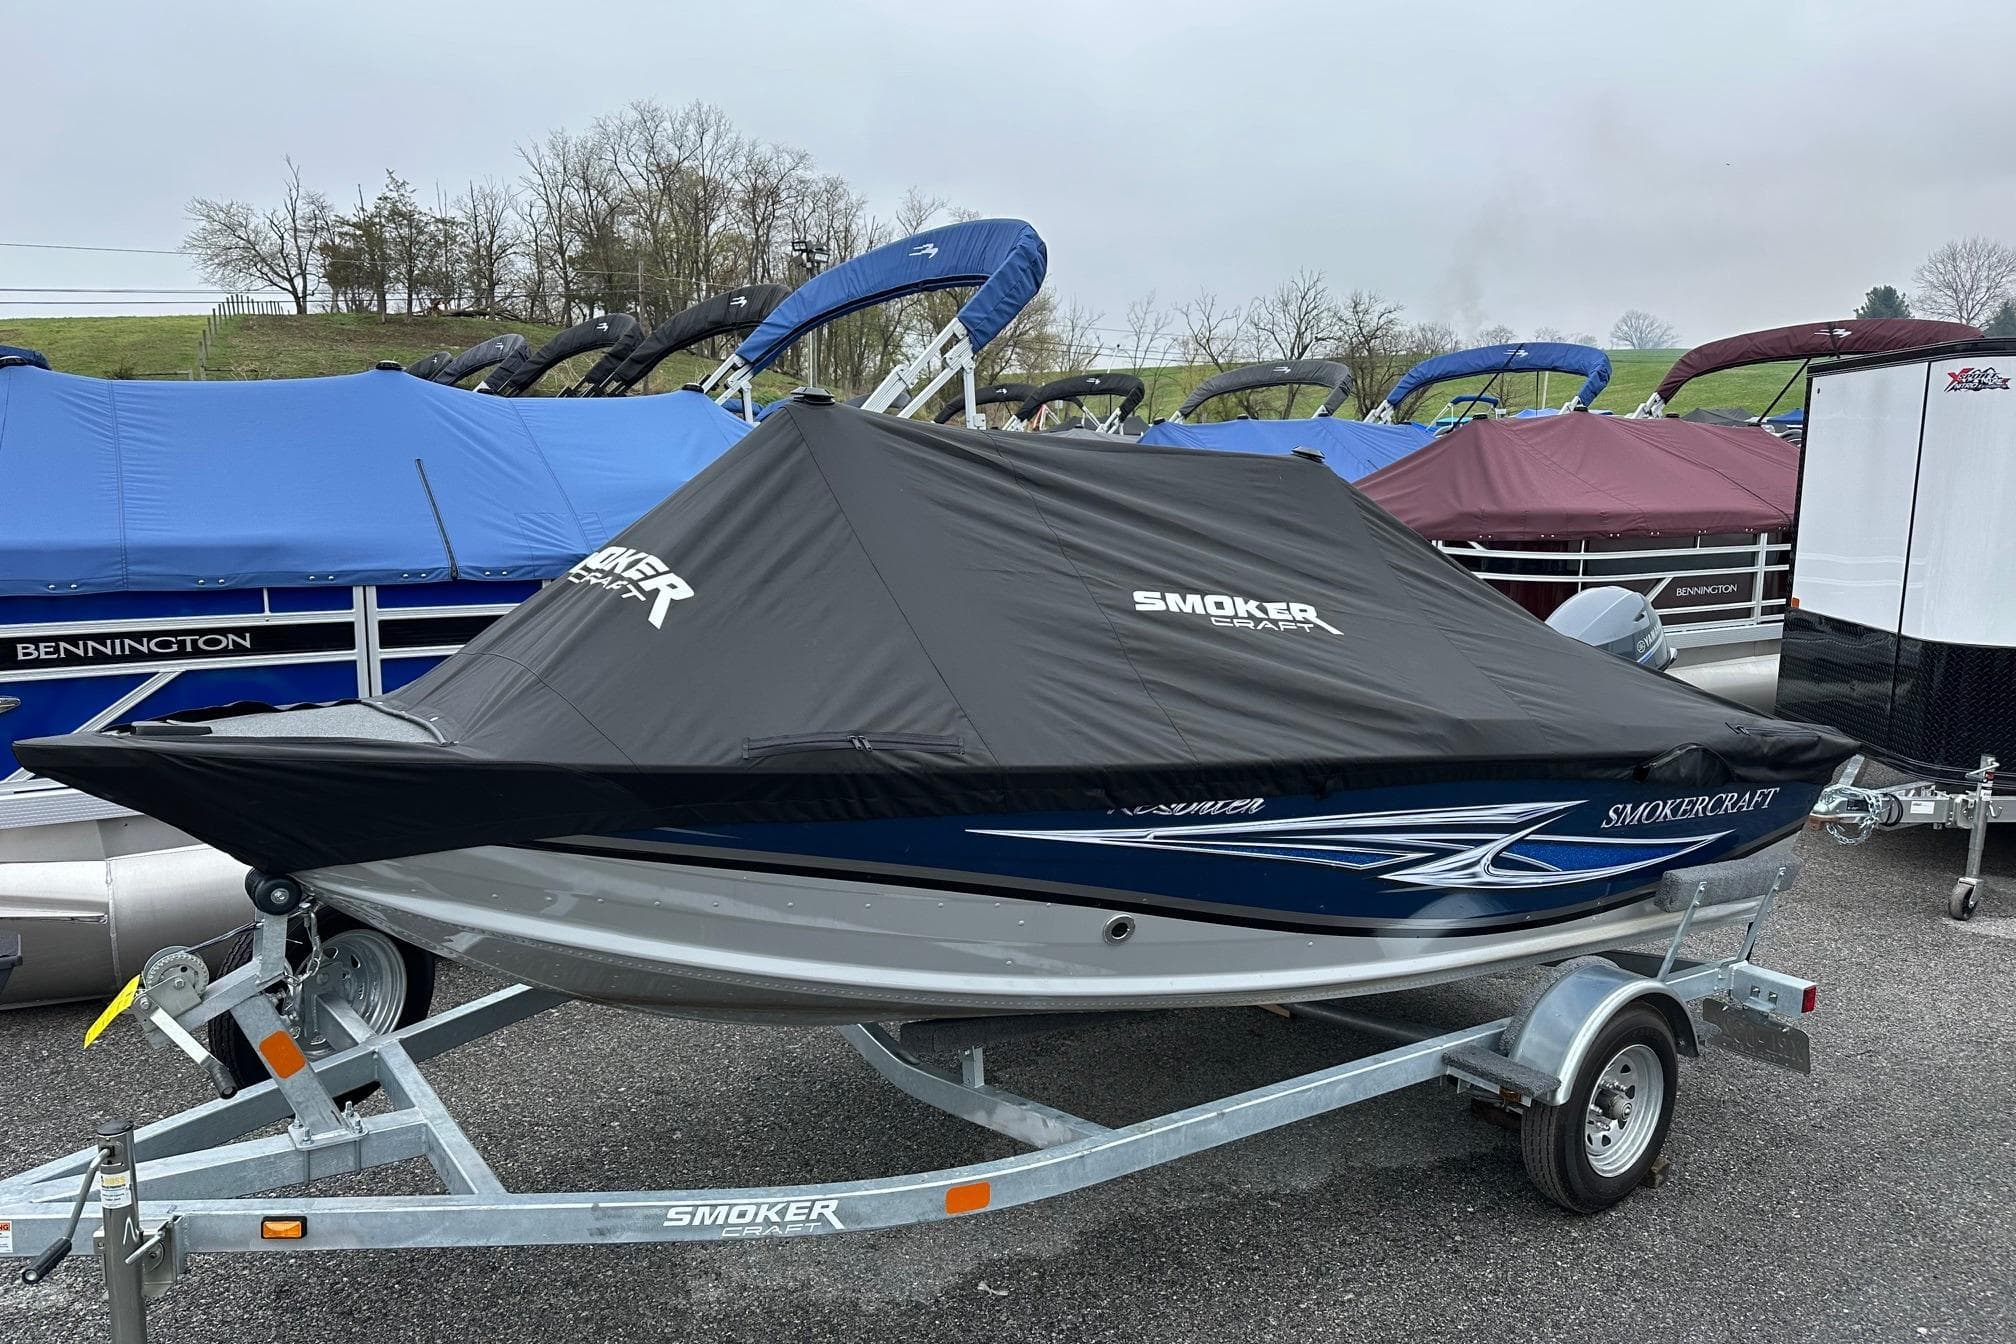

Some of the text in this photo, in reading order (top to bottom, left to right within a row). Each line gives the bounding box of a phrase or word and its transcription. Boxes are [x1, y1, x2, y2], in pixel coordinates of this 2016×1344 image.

[568, 546, 695, 630] OKER
[1676, 584, 1738, 597] BENNINGTON
[1132, 590, 1345, 636] SMOKER
[1210, 616, 1315, 633] CRAFT
[16, 632, 251, 661] BENNINGTON
[1600, 787, 1781, 829] SMOKERCRAFT
[663, 1199, 846, 1230] SMOKER
[720, 1222, 822, 1237] CRAFT
